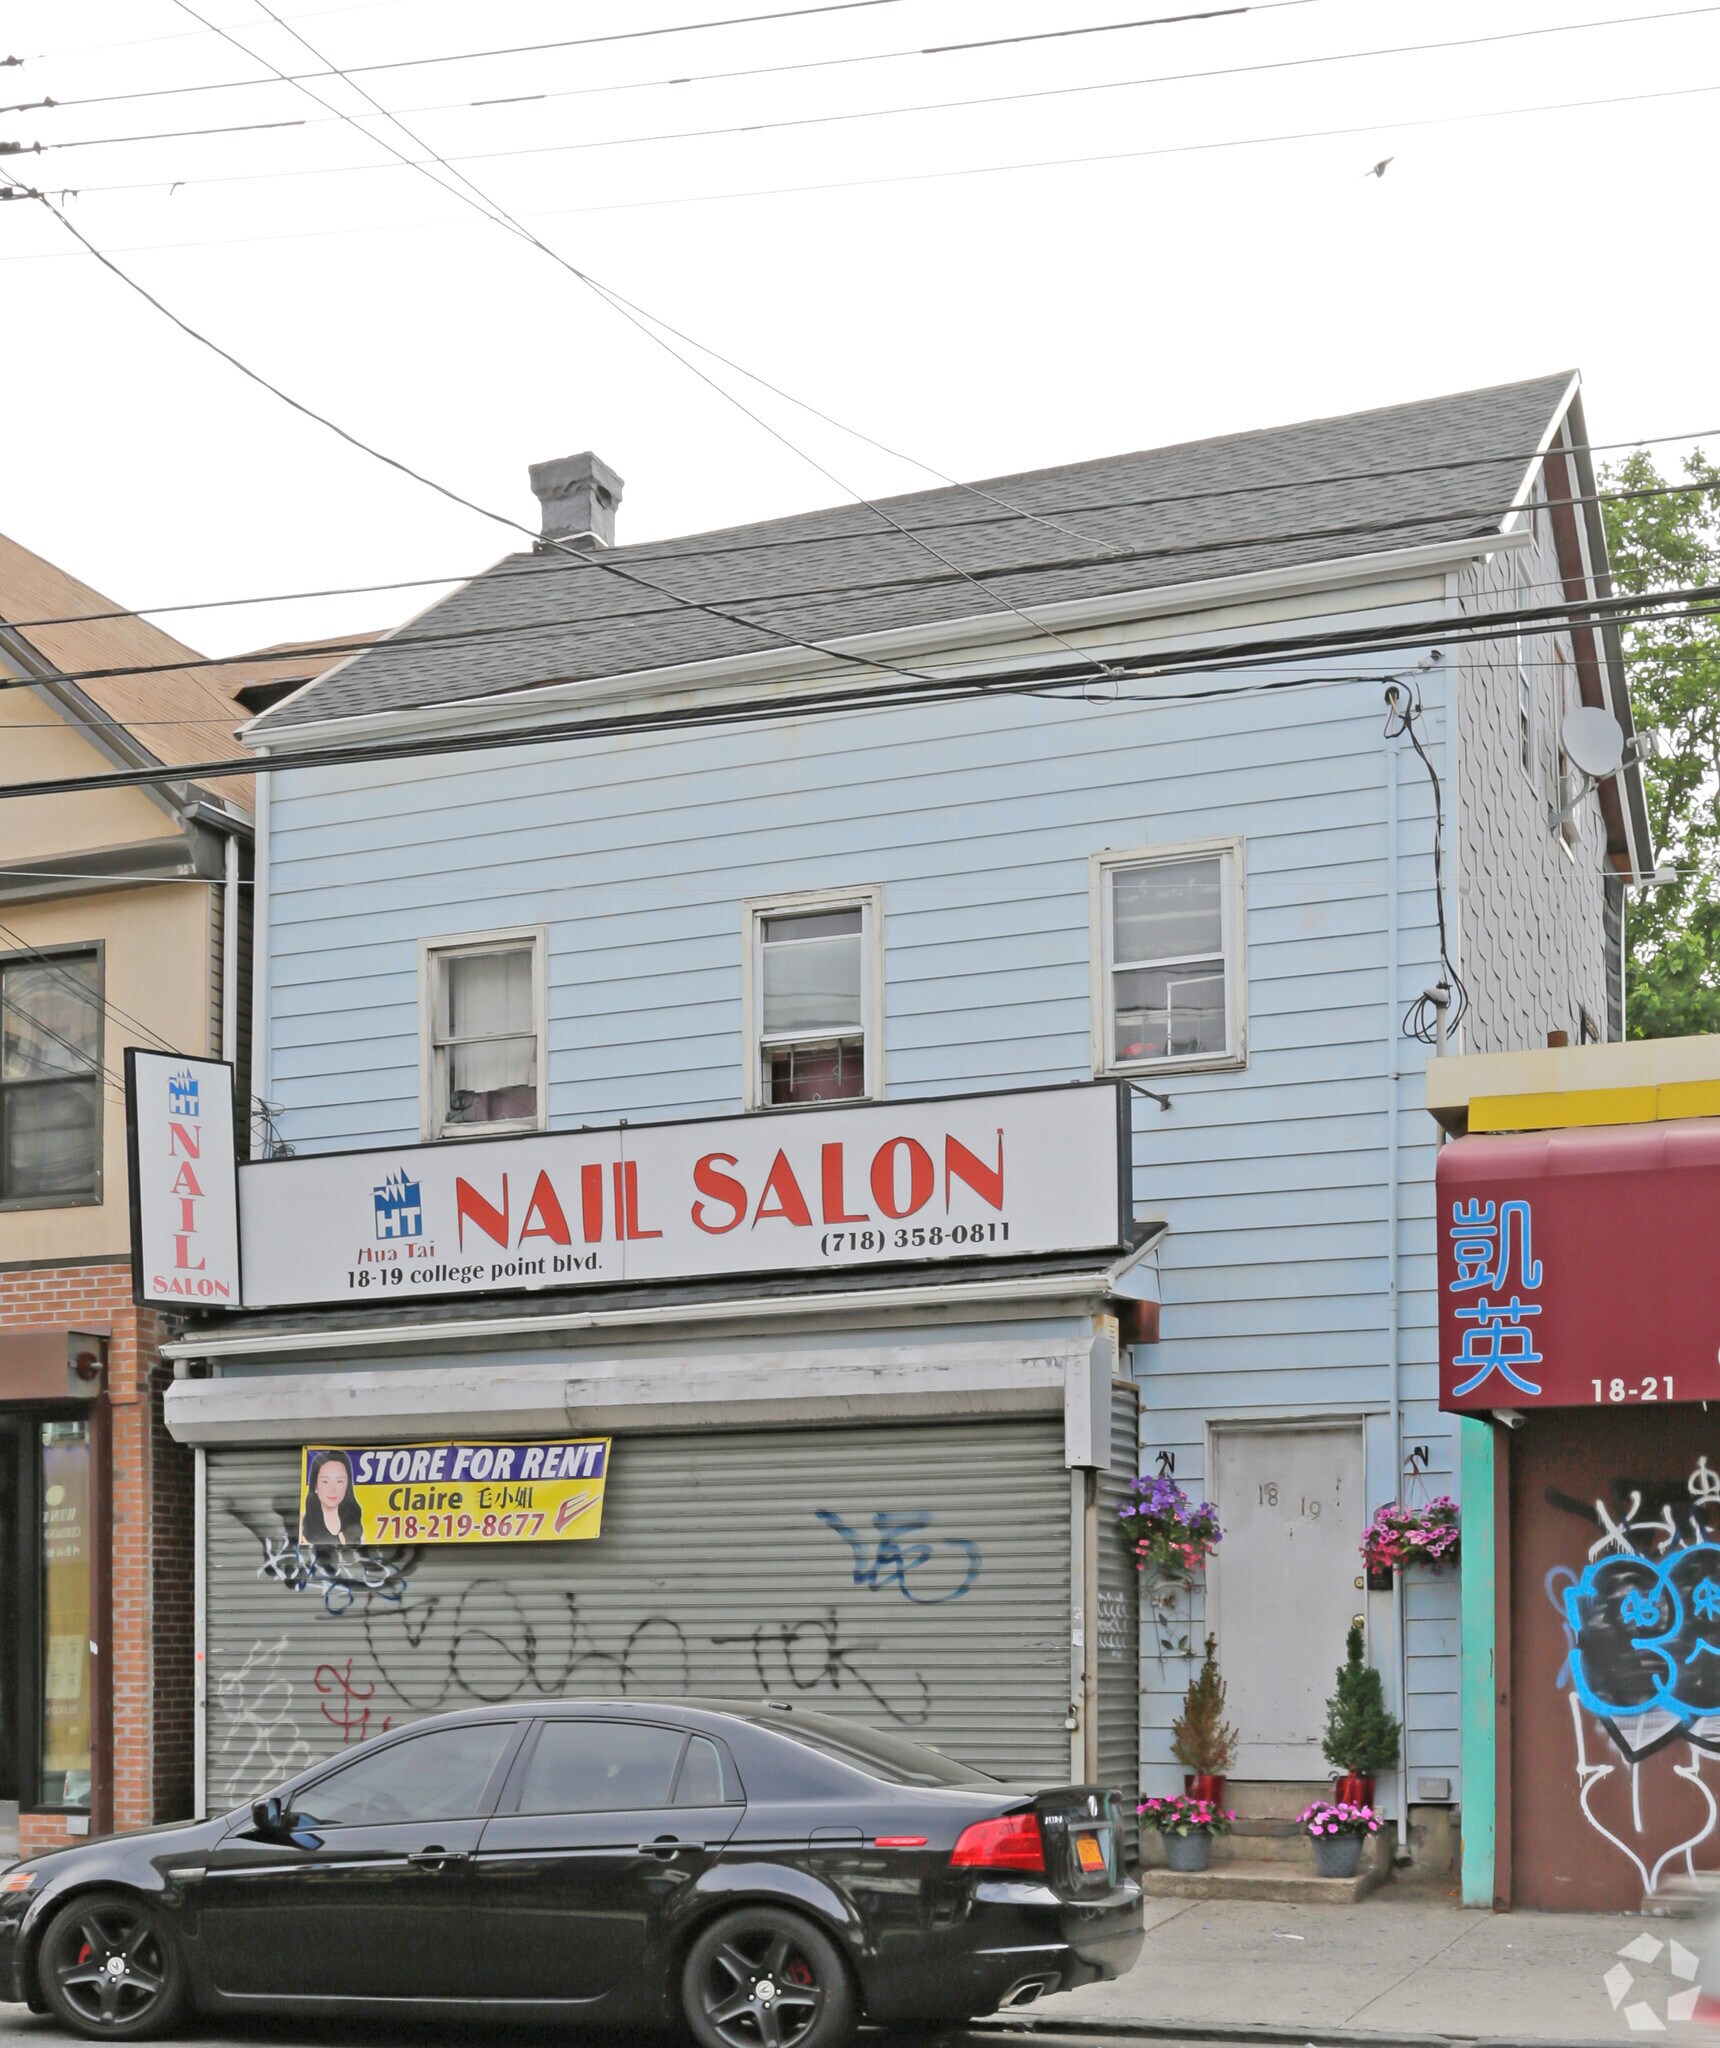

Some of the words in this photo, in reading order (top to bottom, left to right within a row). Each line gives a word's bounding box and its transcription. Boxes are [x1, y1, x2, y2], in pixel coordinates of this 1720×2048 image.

[170, 1093, 199, 1116] HT
[168, 1122, 206, 1271] NAIL
[456, 1160, 663, 1254] NAIL
[691, 1128, 1004, 1235] SALON
[376, 1206, 421, 1239] HT
[357, 1246, 398, 1265] Hua
[404, 1240, 435, 1259] Tai
[821, 1229, 886, 1257] (718)
[894, 1222, 1010, 1248] 358-0811
[152, 1275, 231, 1298] SALON
[348, 1266, 404, 1288] 18-19
[410, 1264, 485, 1284] college
[491, 1256, 546, 1282] point
[553, 1252, 603, 1272] blvd.
[1592, 1376, 1674, 1402] 18-21
[356, 1448, 448, 1483] STORE
[451, 1447, 516, 1480] FOR
[520, 1445, 603, 1479] RENT
[388, 1487, 463, 1511] Claire
[475, 1486, 533, 1509] 毛小姐
[1259, 1485, 1279, 1507] 18
[1301, 1496, 1321, 1520] 19
[375, 1513, 546, 1540] 718-219-8677
